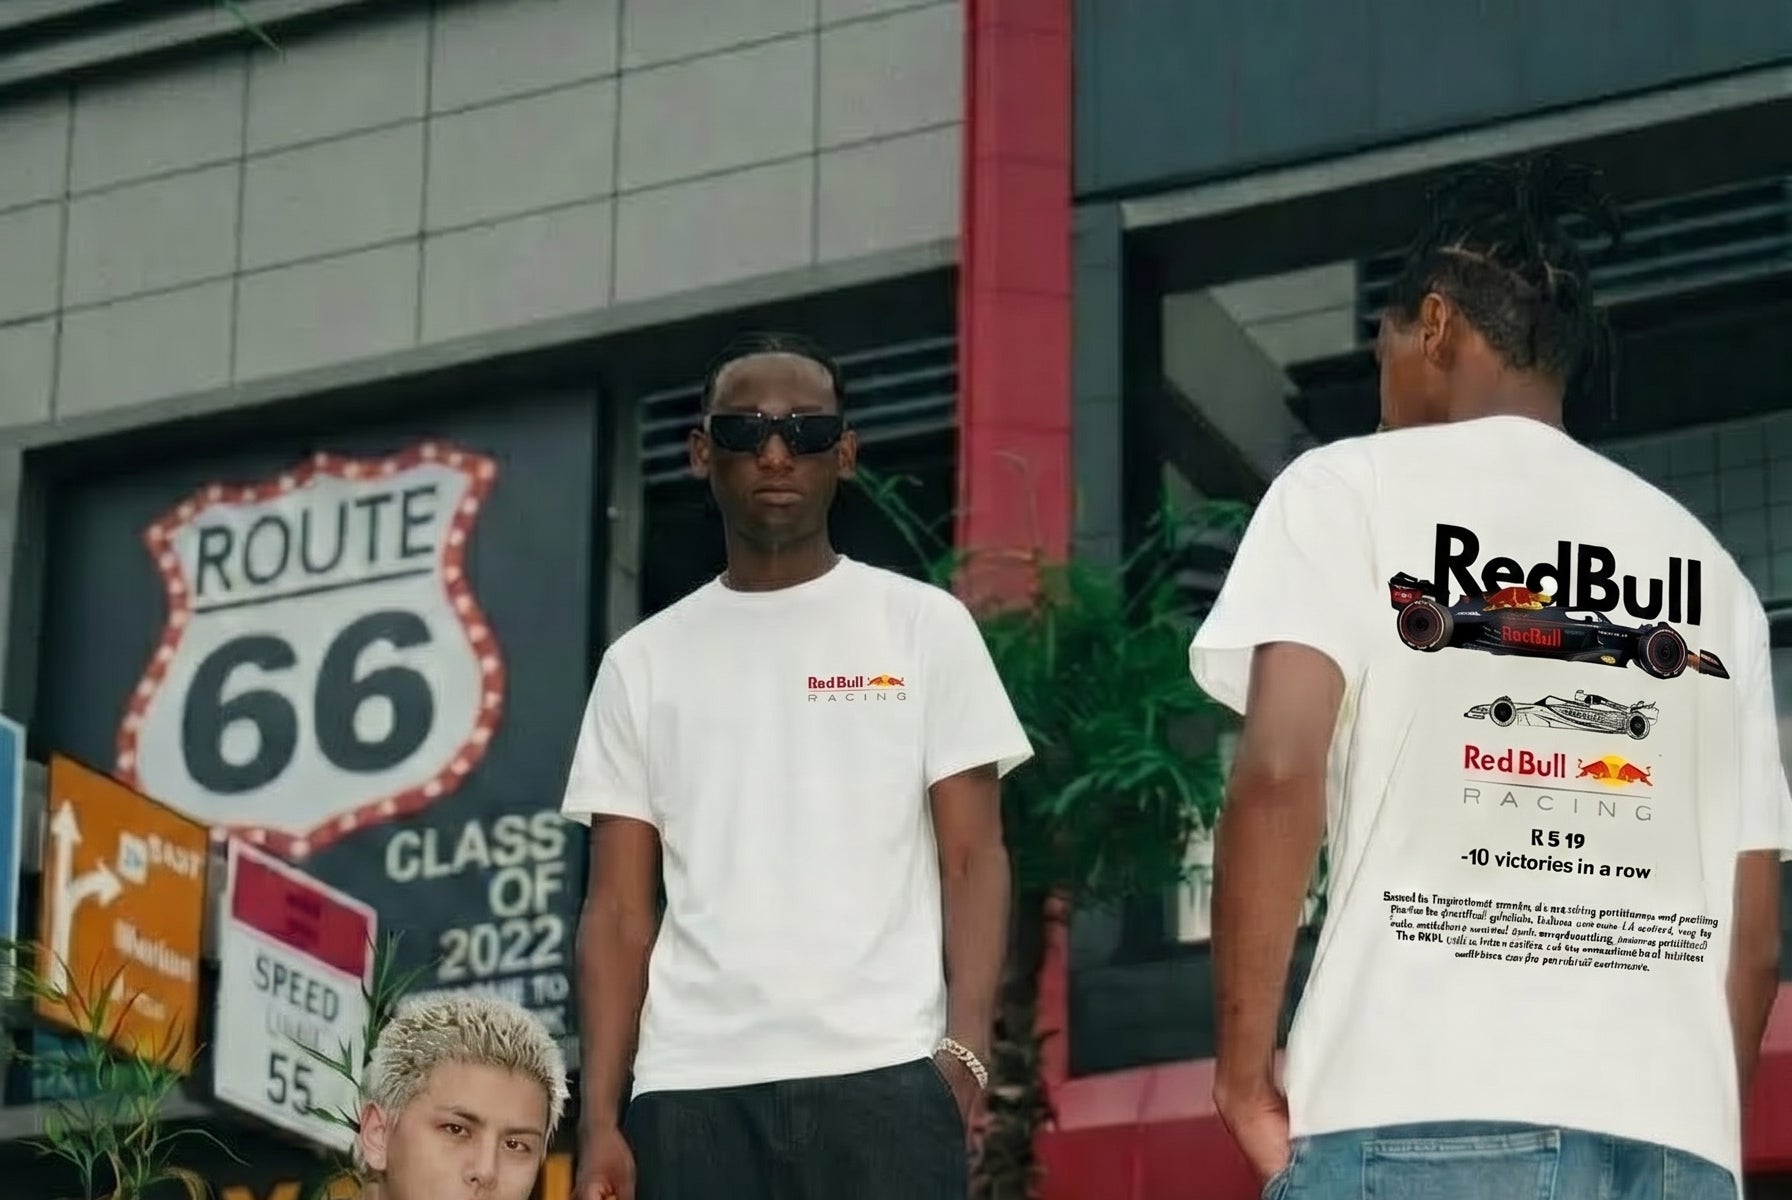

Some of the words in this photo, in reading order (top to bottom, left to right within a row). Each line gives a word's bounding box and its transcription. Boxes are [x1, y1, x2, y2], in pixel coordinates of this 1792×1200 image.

[197, 484, 438, 597] ROUTE
[1433, 523, 1702, 626] RedBull
[182, 610, 435, 796] 66
[807, 676, 835, 689] Red
[836, 675, 864, 689] Bull
[807, 692, 907, 702] RACING
[1464, 744, 1513, 773] Red
[1518, 750, 1566, 779] Bull
[1463, 787, 1652, 821] RACING
[385, 810, 567, 883] CLASS
[1461, 848, 1489, 867] -10
[1494, 851, 1574, 874] victories
[1577, 858, 1595, 875] in
[1599, 863, 1611, 877] a
[1616, 865, 1651, 879] row
[1565, 833, 1586, 850] 19
[489, 860, 565, 918] OF
[437, 914, 563, 983] 2022
[253, 953, 340, 1023] SPEED
[266, 1052, 314, 1116] 55
